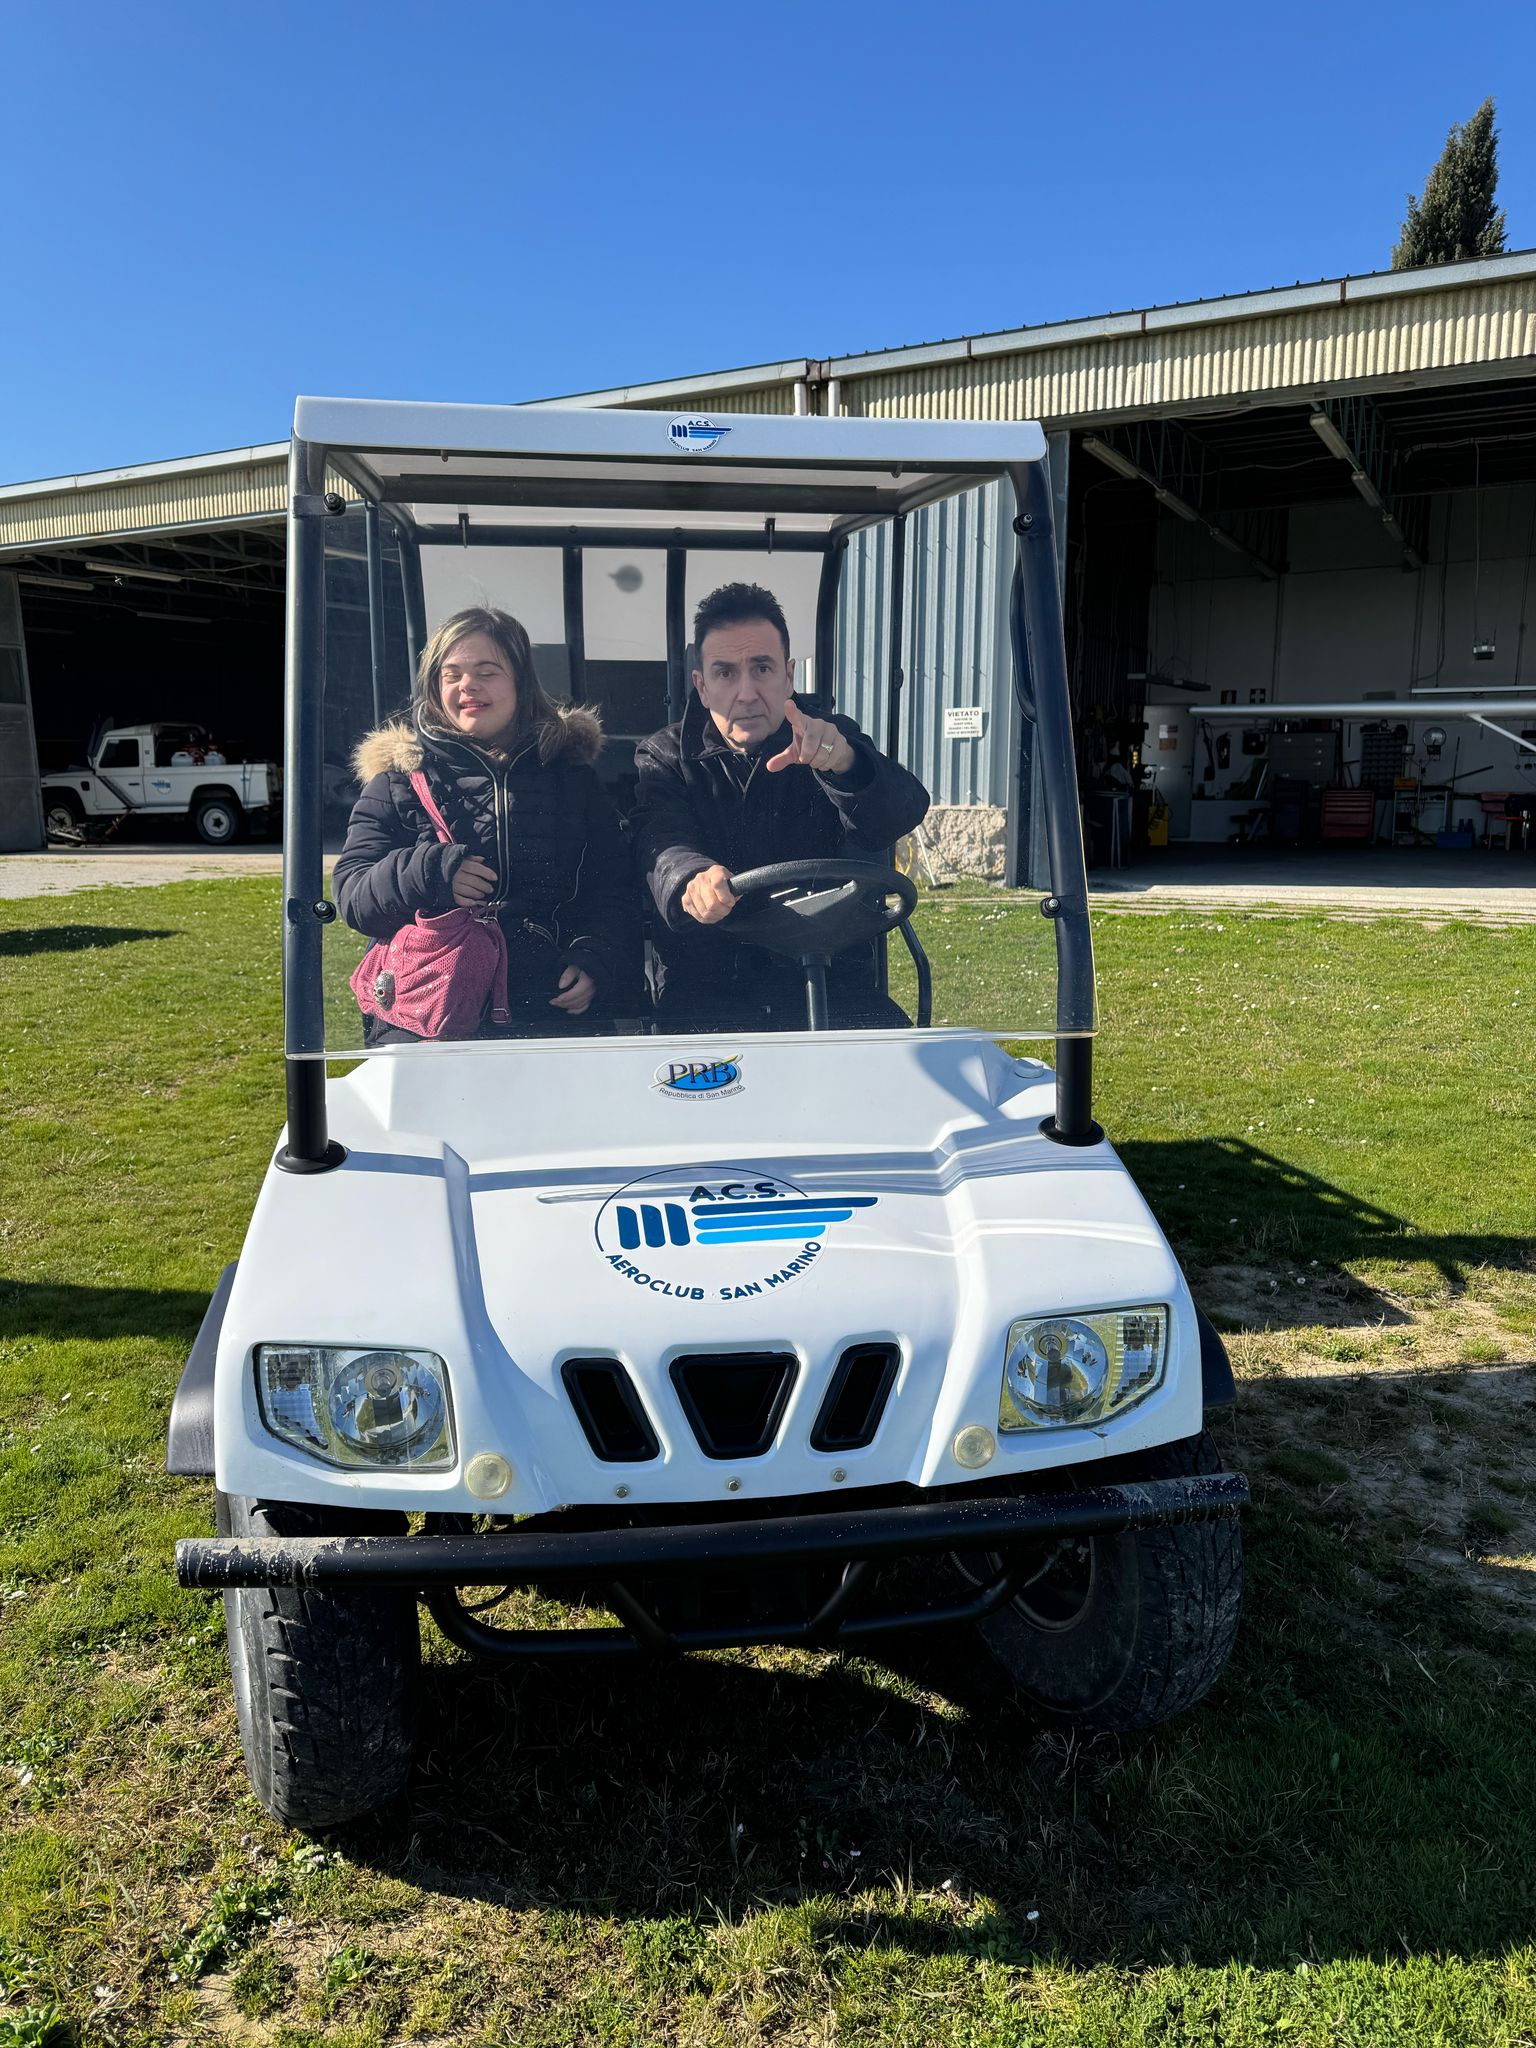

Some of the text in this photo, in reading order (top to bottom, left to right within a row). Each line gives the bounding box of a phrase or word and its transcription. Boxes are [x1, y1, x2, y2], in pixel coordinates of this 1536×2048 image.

[668, 1062, 732, 1084] PRB
[659, 1087, 697, 1099] Repubblica
[720, 1085, 743, 1096] Marino
[689, 1182, 785, 1202] A.C.S.
[605, 1241, 821, 1301] AEROCLUB SAN MARINO
